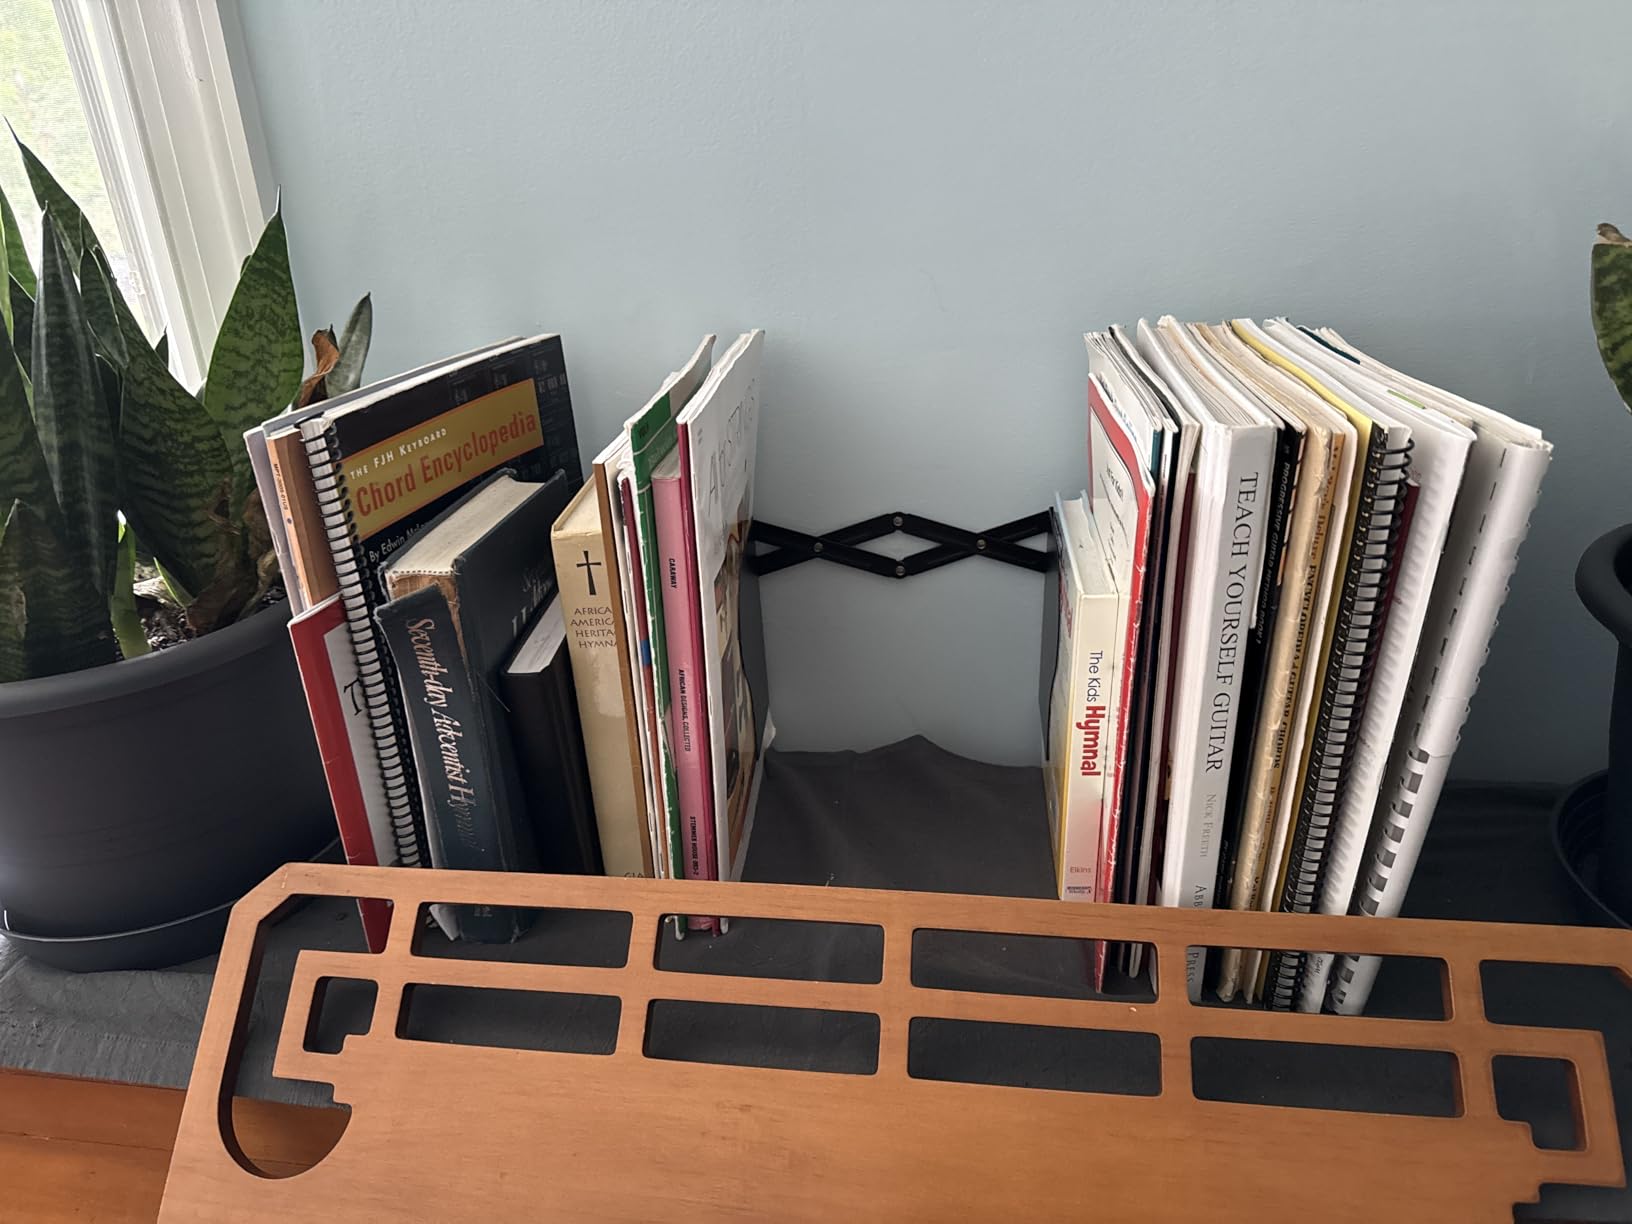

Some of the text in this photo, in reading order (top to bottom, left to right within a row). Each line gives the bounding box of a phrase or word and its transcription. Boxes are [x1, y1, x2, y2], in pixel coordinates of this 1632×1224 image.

[350, 428, 448, 480] THE FJH KEYBOARD
[356, 412, 537, 517] Chord Encyclopedia
[1231, 472, 1259, 558] TEACH
[1274, 462, 1291, 530] PROGRESSIVE
[369, 536, 406, 563] By Edwin
[668, 558, 678, 588] CARAWAY
[1216, 564, 1247, 686] YOURSELF
[406, 618, 454, 708] Seventh-day
[430, 708, 471, 790] Adventist
[678, 669, 688, 694] AFRICAN
[1076, 650, 1106, 776] The Kids Hymnal
[682, 720, 692, 752] COLLECTED
[1205, 692, 1232, 773] GUITAR
[1070, 866, 1092, 874] Elkins
